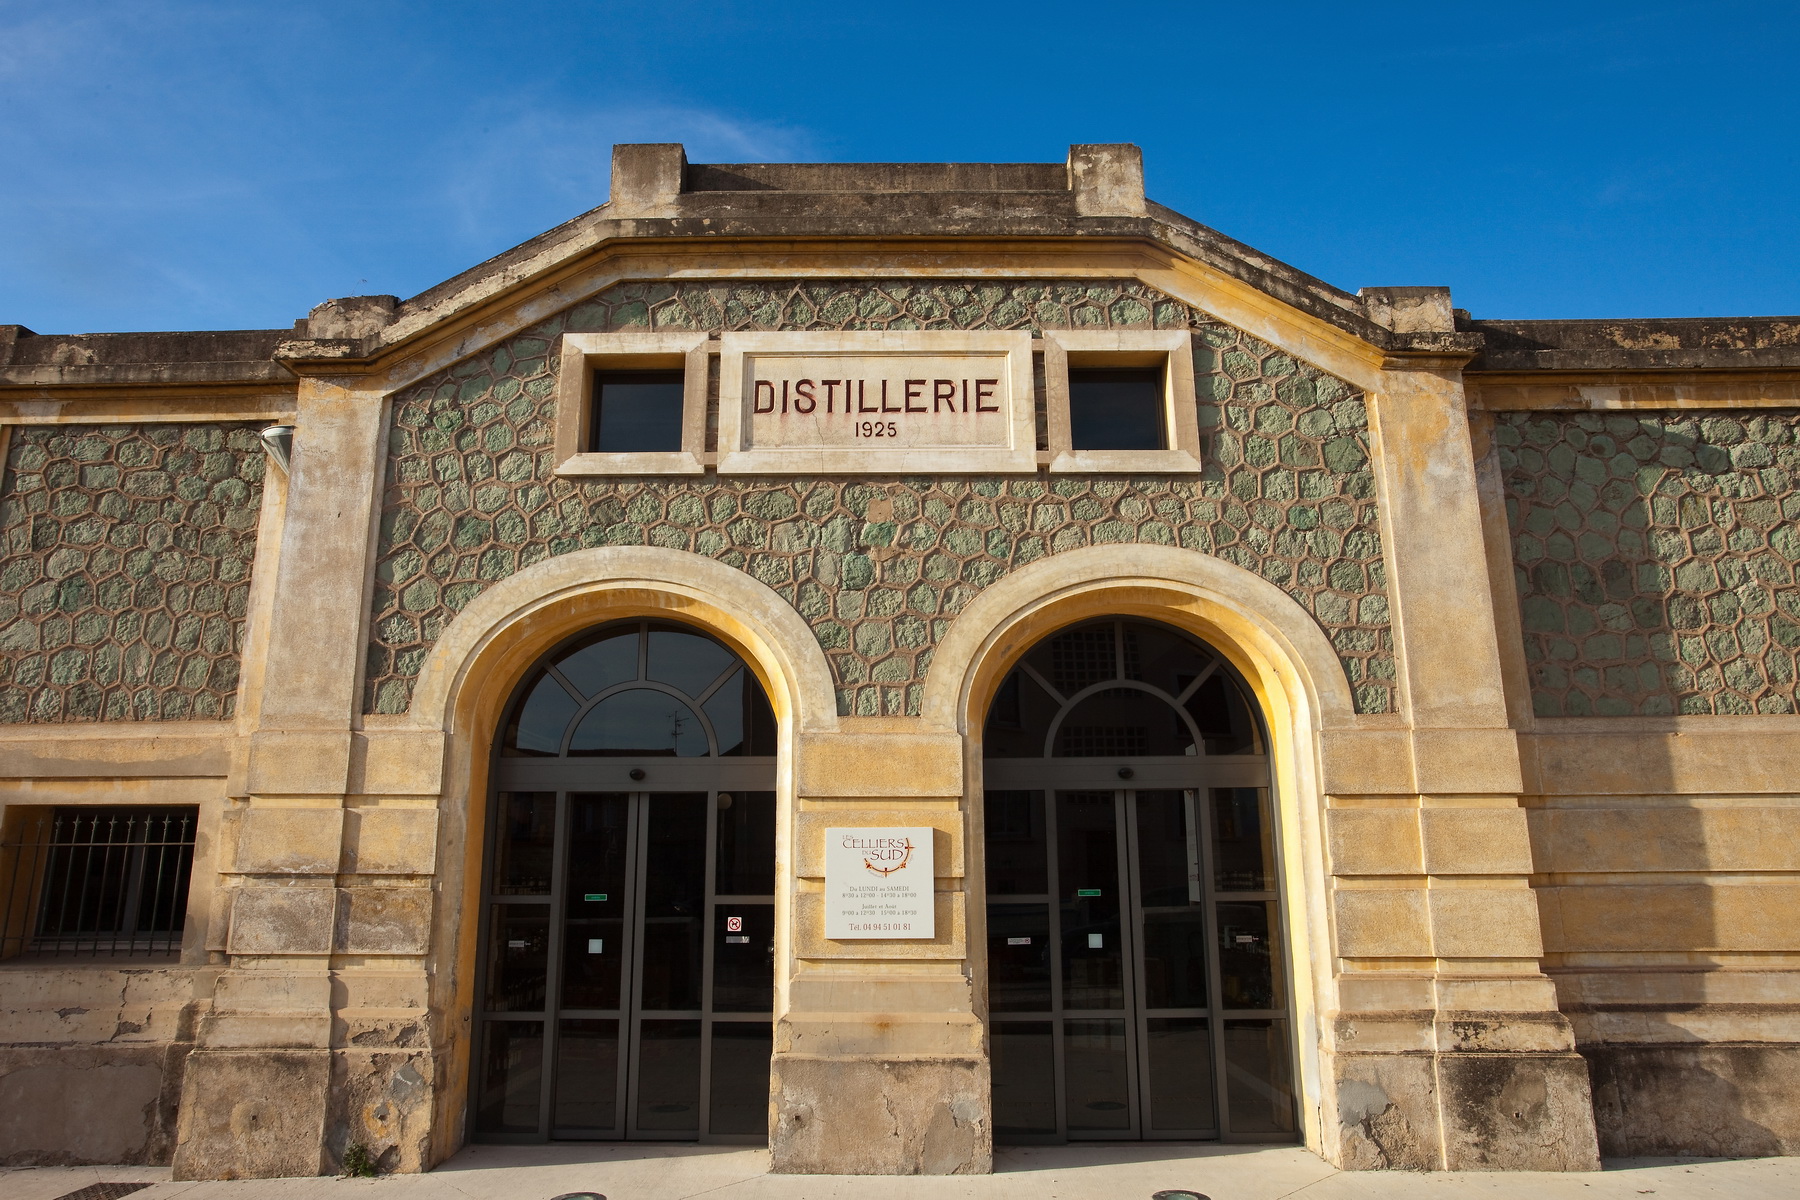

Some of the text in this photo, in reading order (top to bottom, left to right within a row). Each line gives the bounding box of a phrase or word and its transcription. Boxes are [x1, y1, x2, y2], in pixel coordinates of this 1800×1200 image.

[753, 378, 1000, 414] DISTILLERIE
[855, 421, 898, 438] 1925
[842, 838, 904, 849] CELLIERS
[870, 849, 904, 861] SUD
[863, 923, 871, 931] 04
[873, 923, 881, 931] 94
[883, 923, 891, 931] 51
[893, 923, 901, 931] 01
[903, 923, 911, 931] 81
